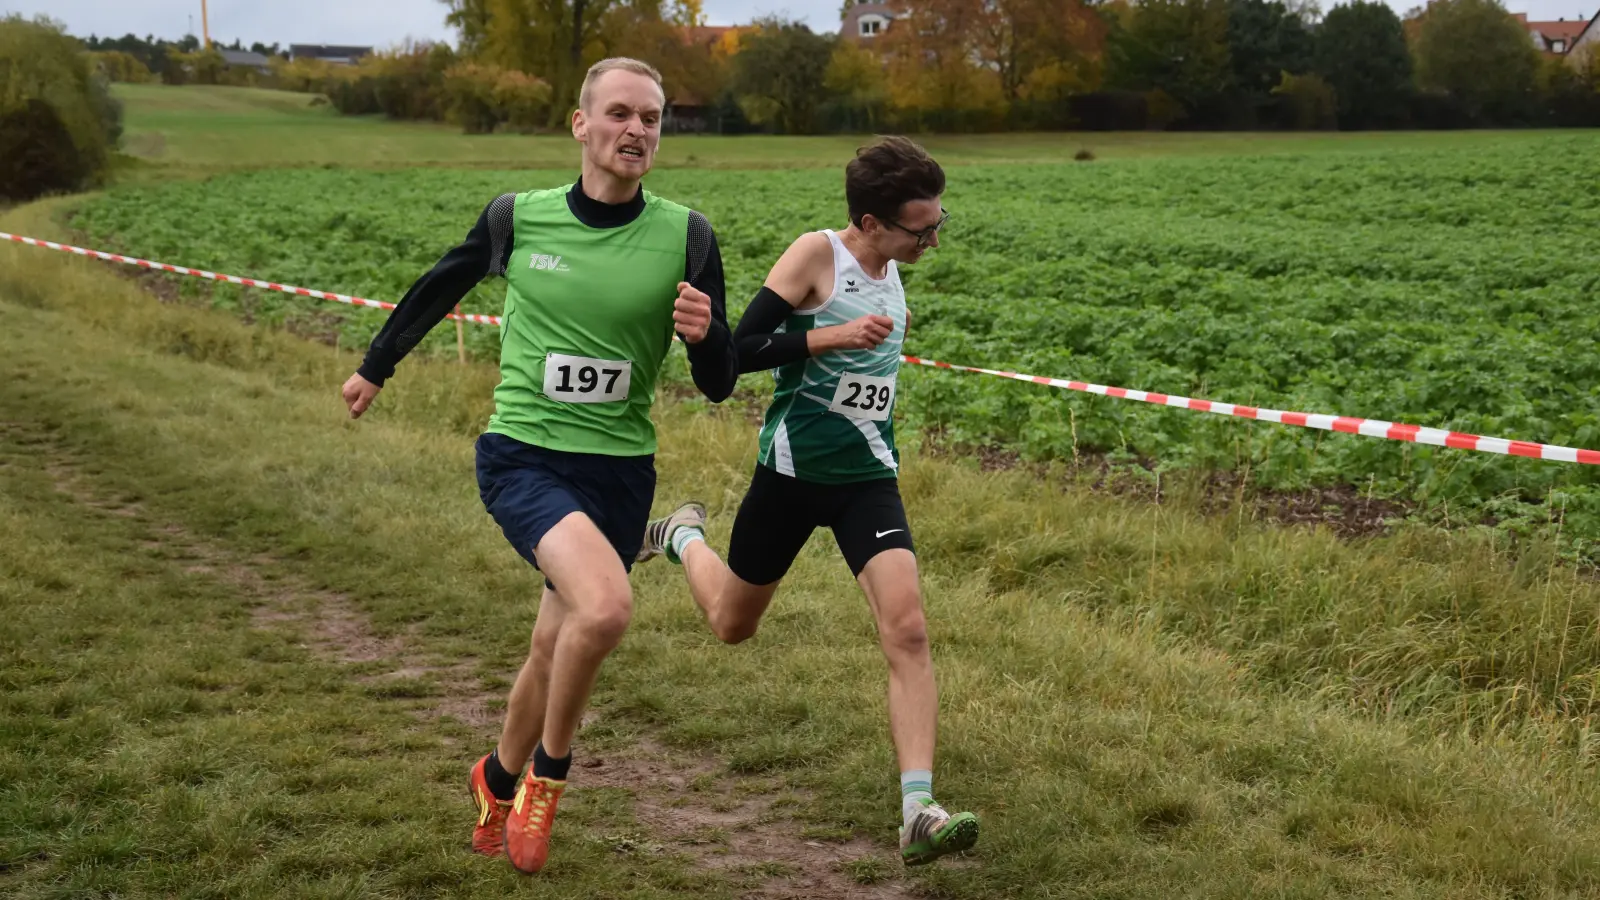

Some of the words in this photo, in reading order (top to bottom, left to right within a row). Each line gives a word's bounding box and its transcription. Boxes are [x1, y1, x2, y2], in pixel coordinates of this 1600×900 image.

[529, 253, 562, 271] TSV
[555, 365, 622, 394] 197
[841, 382, 890, 412] 239
